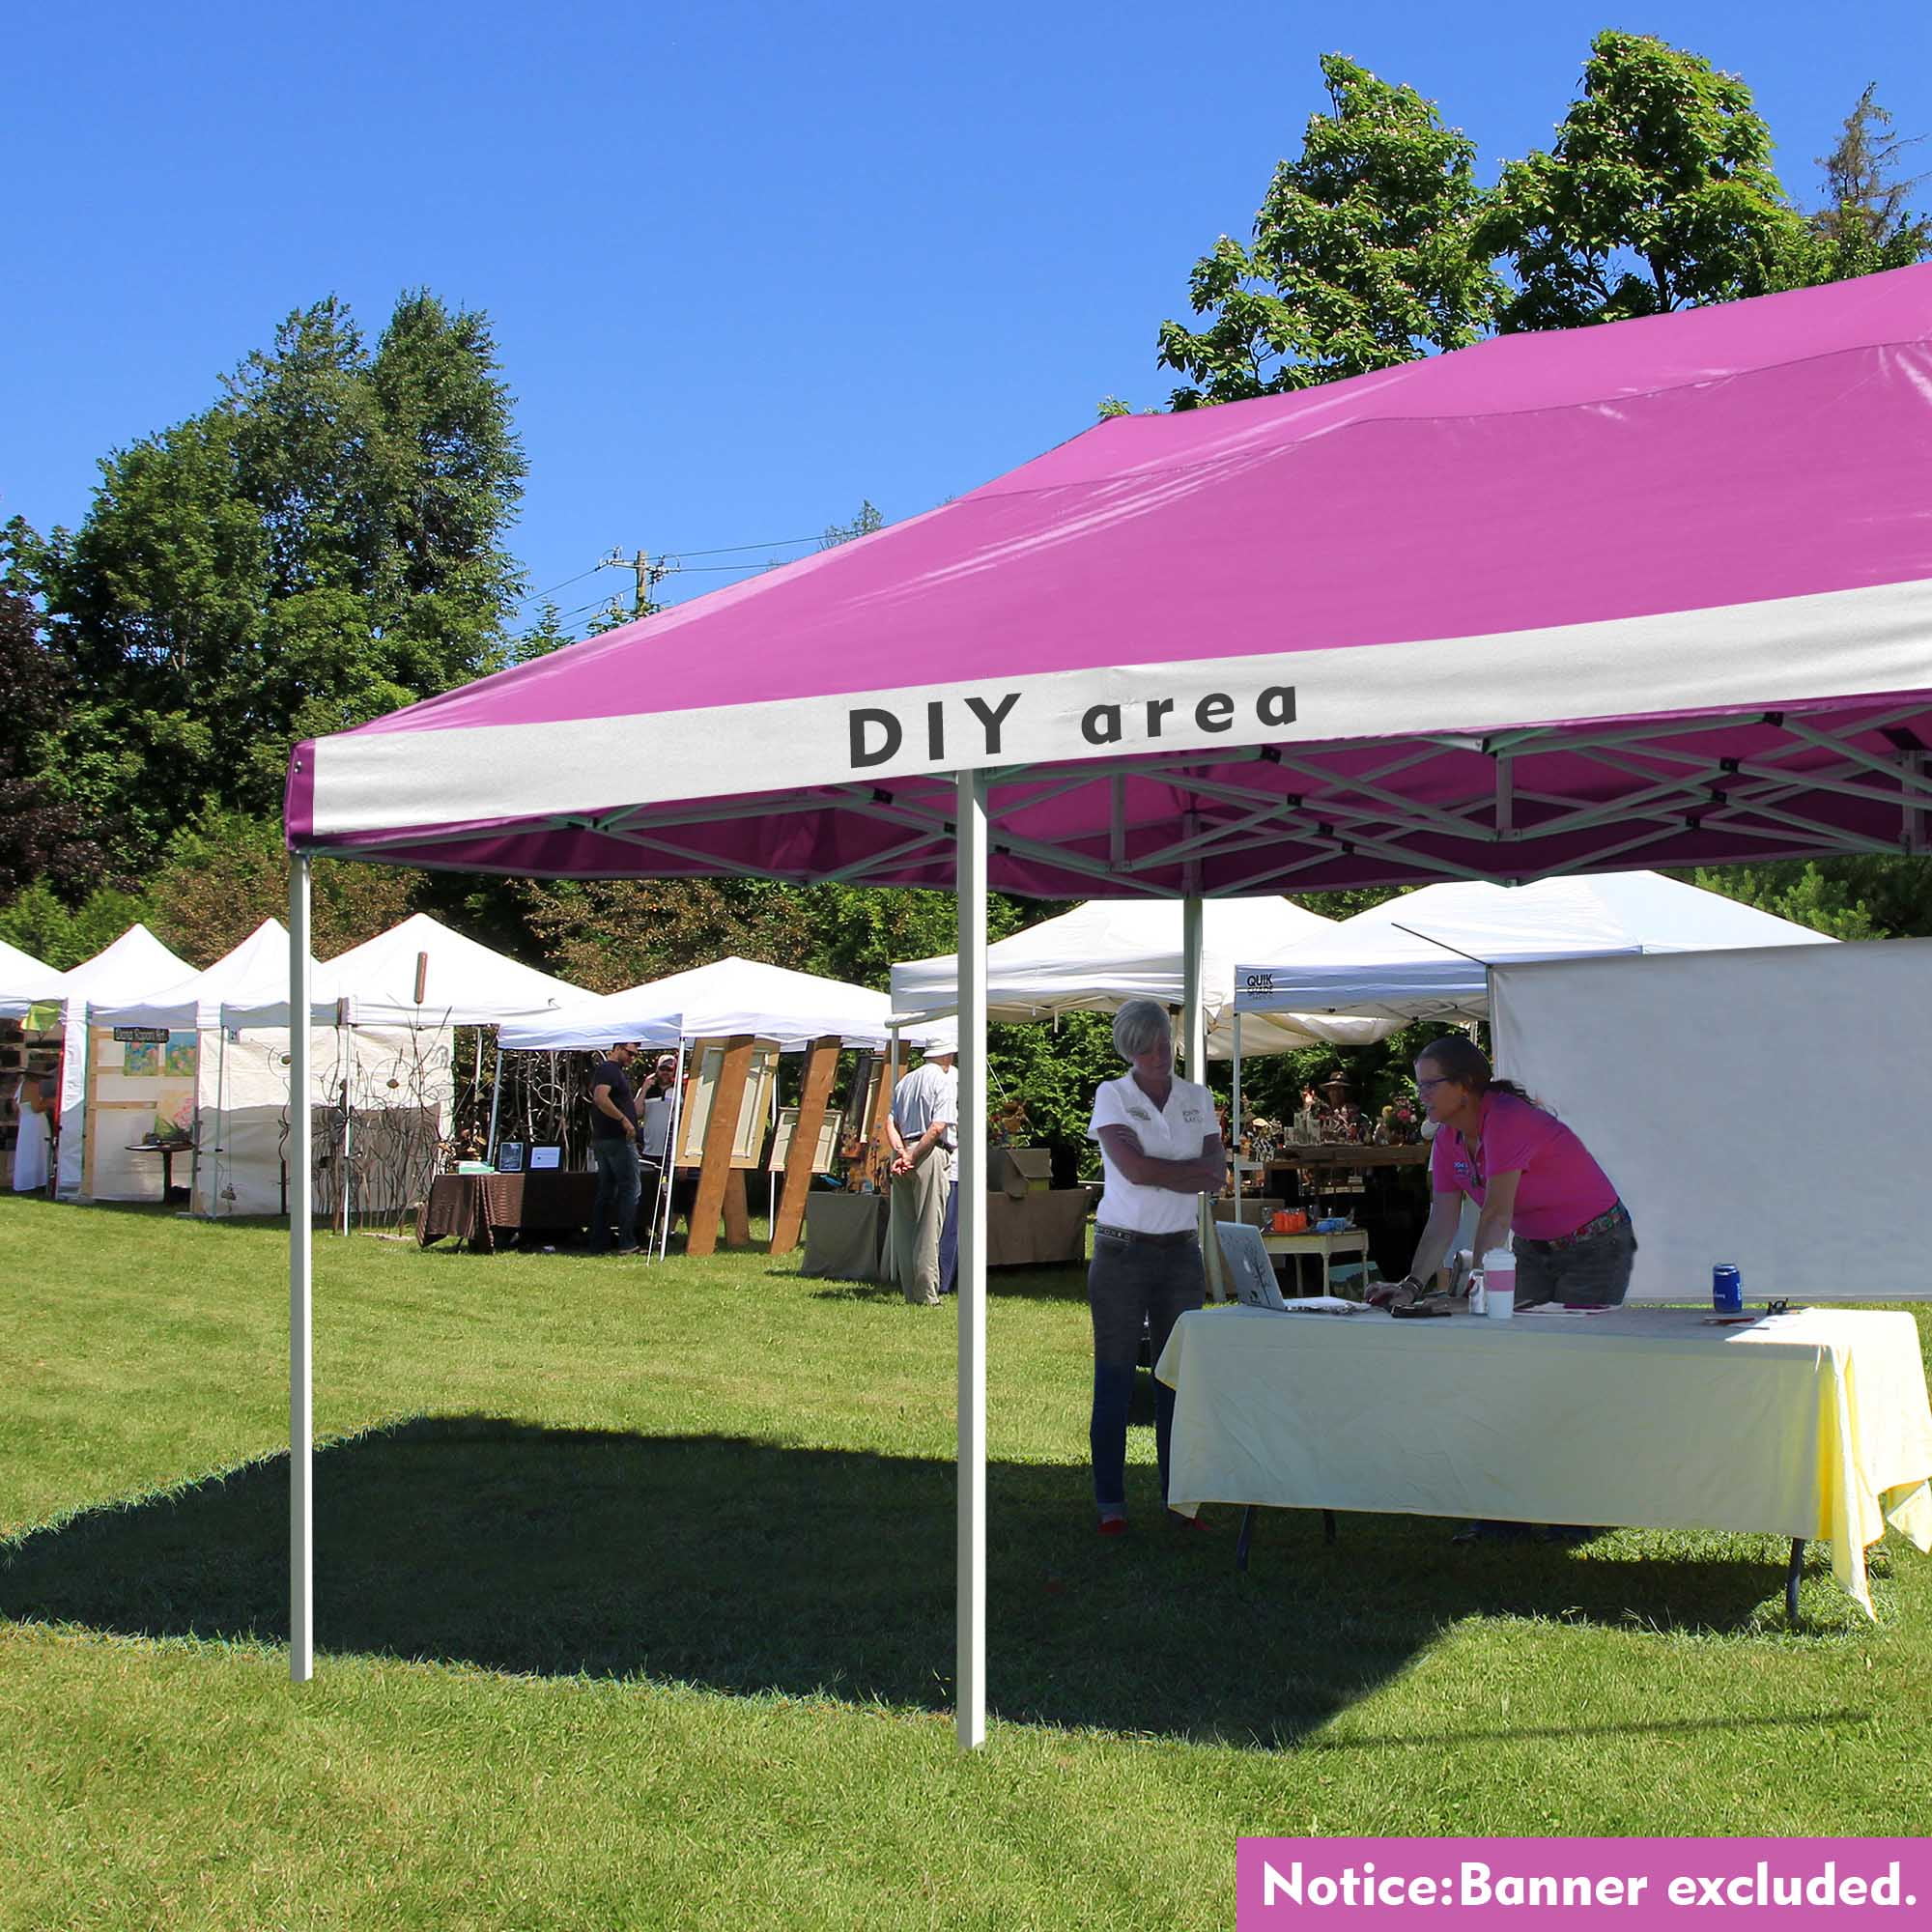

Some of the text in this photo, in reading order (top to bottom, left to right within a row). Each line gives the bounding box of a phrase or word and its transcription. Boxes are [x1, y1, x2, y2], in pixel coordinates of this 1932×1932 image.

[849, 686, 1297, 769] DIY area
[1246, 974, 1273, 987] QUIK
